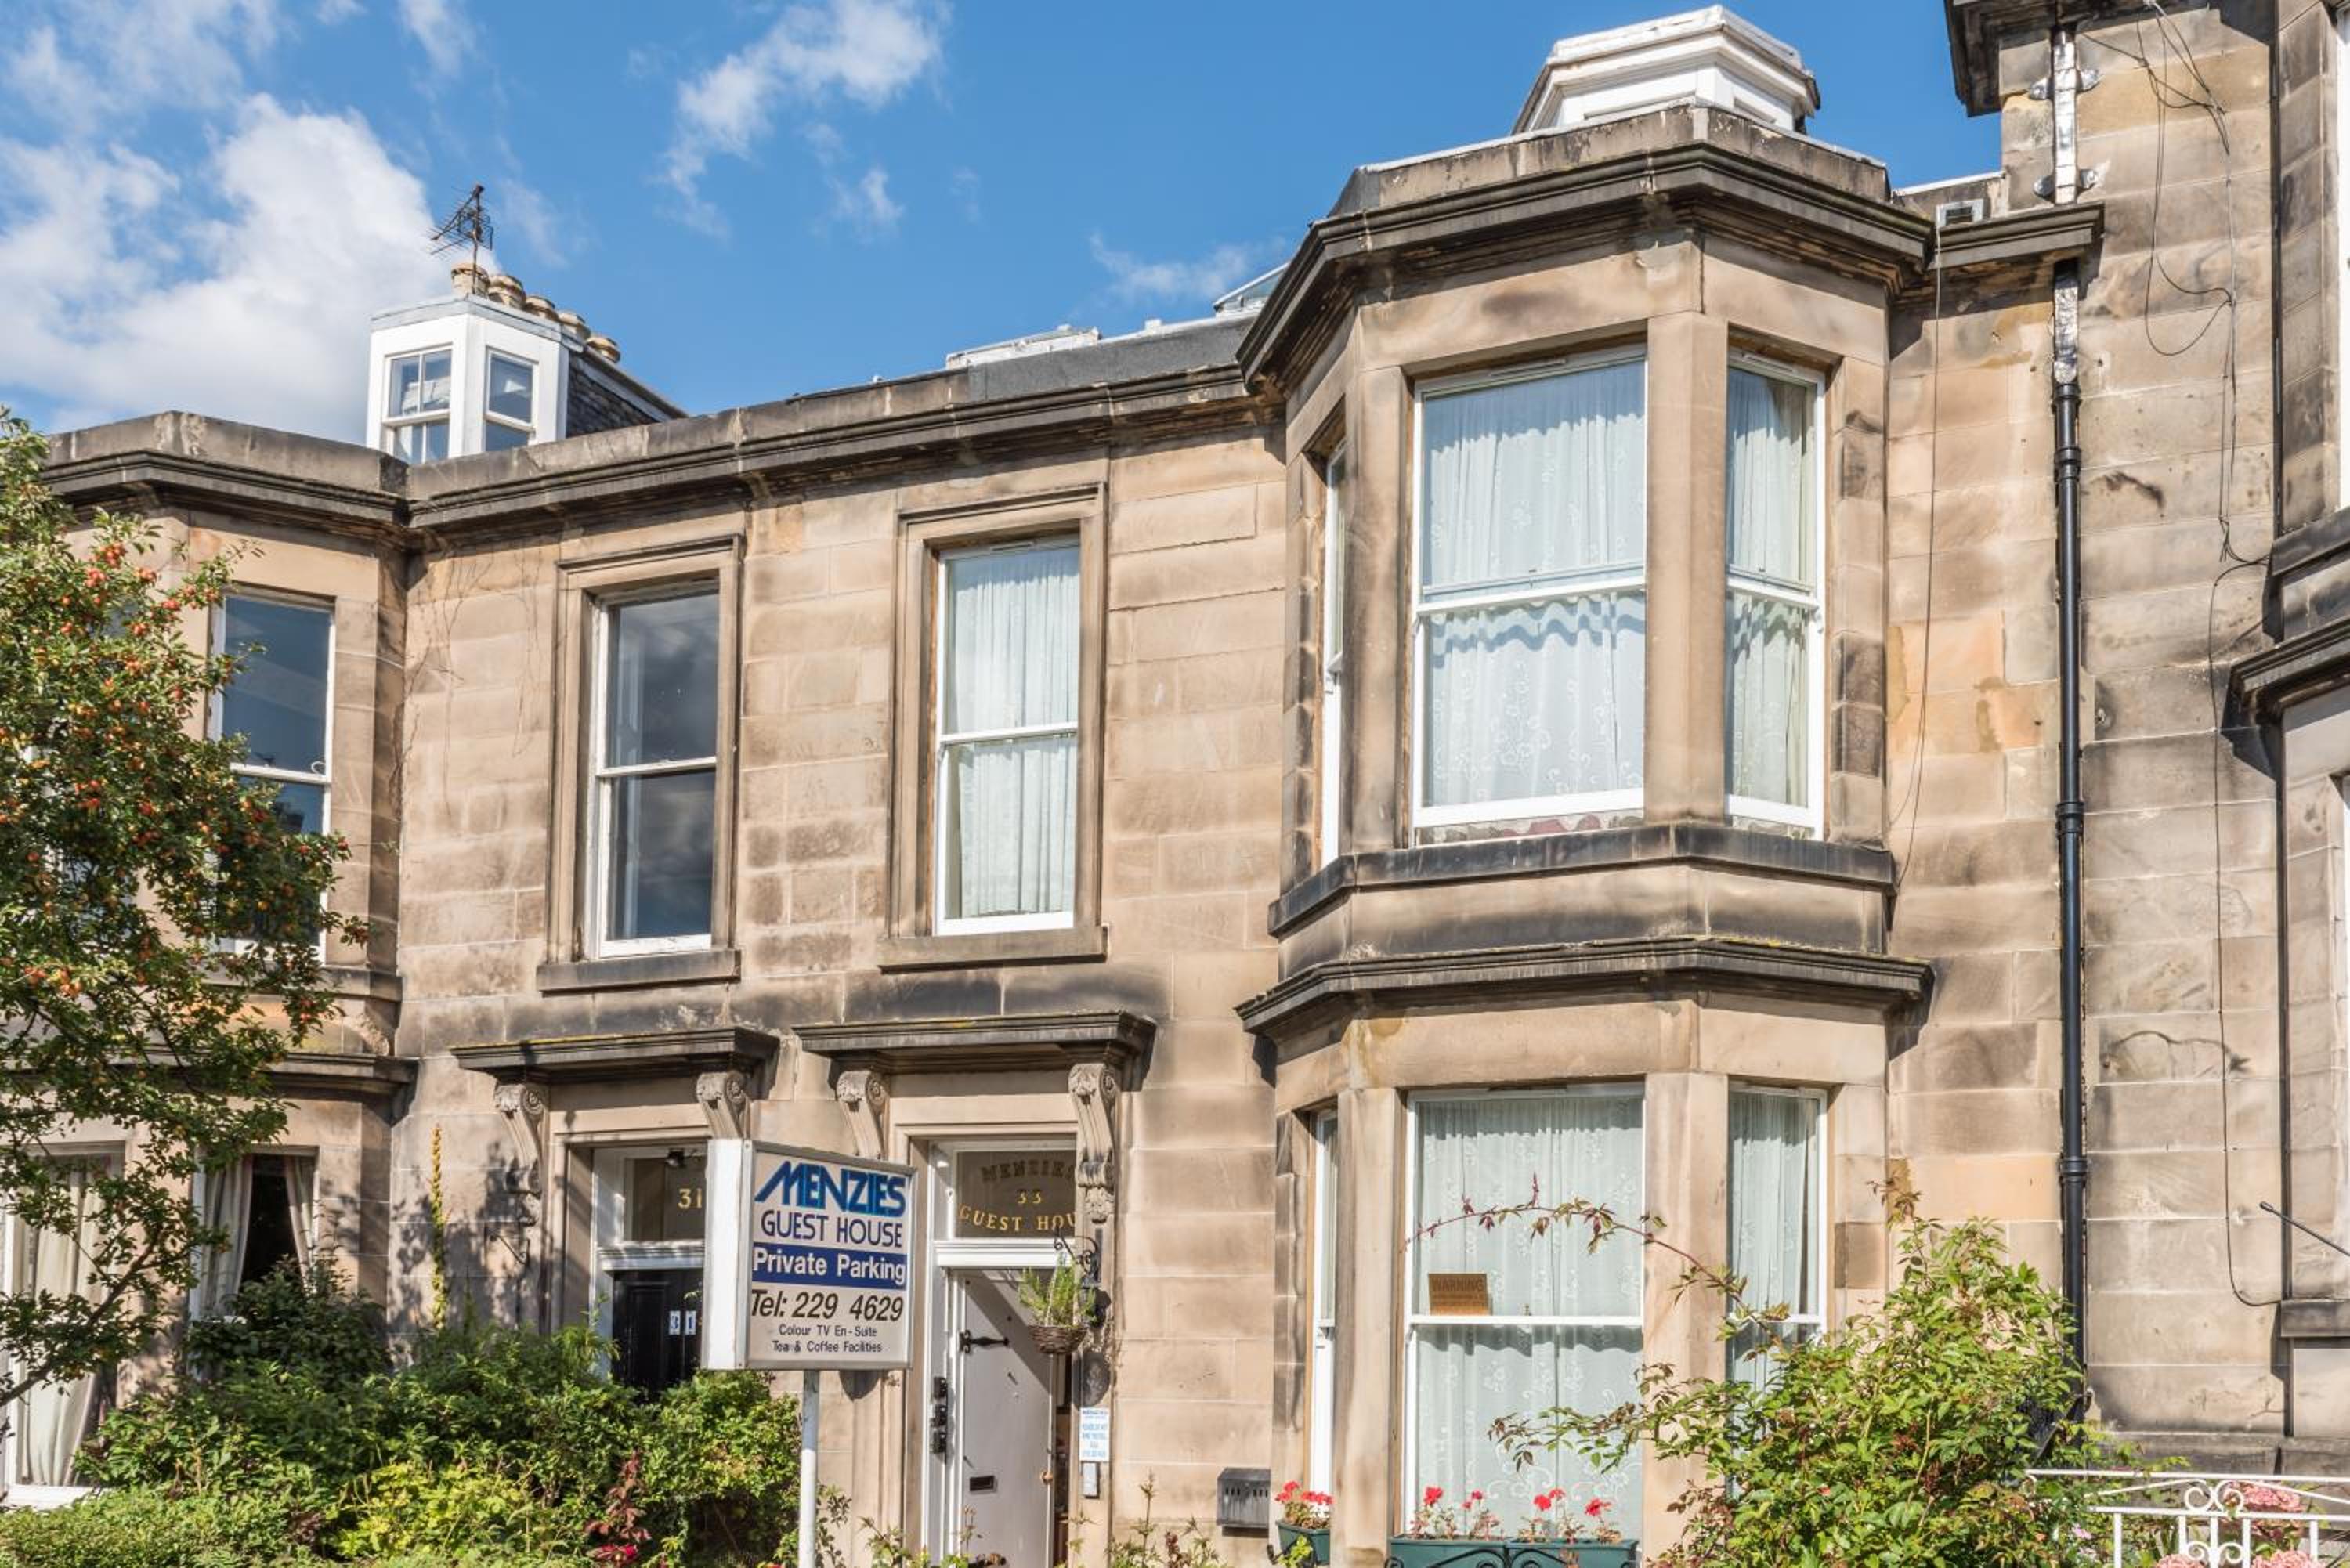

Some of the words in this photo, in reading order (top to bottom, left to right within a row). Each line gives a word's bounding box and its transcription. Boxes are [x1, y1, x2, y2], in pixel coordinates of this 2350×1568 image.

[678, 1188, 703, 1209] 31
[754, 1160, 906, 1217] MENZIES
[1018, 1189, 1043, 1204] 33
[761, 1210, 829, 1241] GUEST
[837, 1216, 903, 1248] HOUSE
[958, 1203, 1022, 1232] GUEST
[753, 1248, 827, 1276] Private
[837, 1254, 906, 1284] Parking
[1432, 1278, 1484, 1292] WARNING
[751, 1289, 787, 1317] Tel:
[792, 1292, 839, 1319] 229
[850, 1295, 904, 1321] 4629
[779, 1323, 811, 1336] Colour
[817, 1324, 830, 1336] TV
[772, 1340, 790, 1353] Tea
[794, 1340, 801, 1353] &
[808, 1340, 840, 1353] Coffee
[843, 1342, 883, 1353] Facilities
